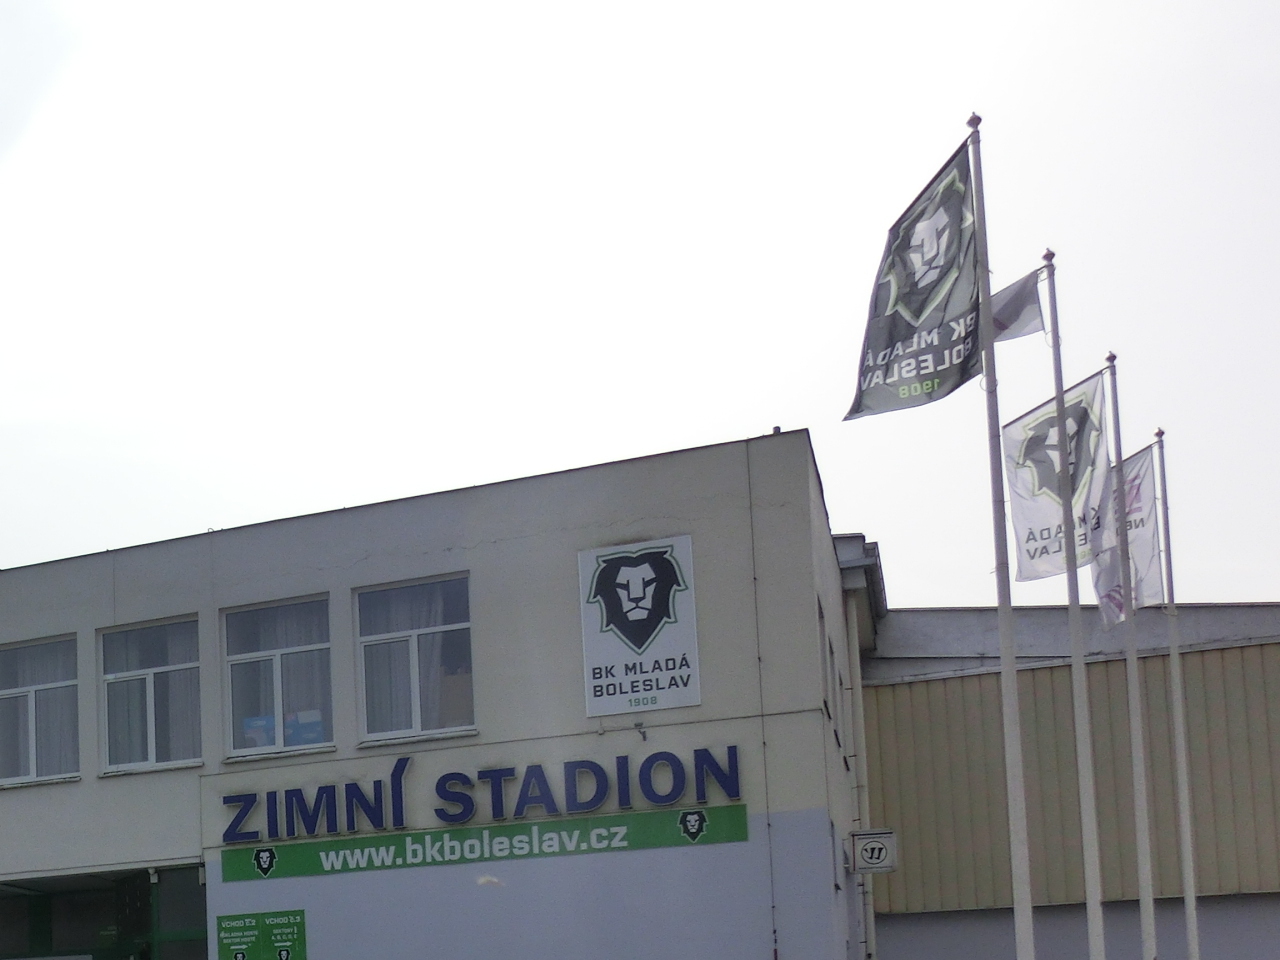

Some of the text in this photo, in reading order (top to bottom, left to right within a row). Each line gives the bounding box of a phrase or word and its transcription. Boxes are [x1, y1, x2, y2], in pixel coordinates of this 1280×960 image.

[592, 653, 691, 680] BK MLADÁ
[593, 674, 691, 698] BOLESLAV
[628, 696, 658, 708] 1908
[222, 744, 742, 845] ZIMNÍ STADION
[320, 824, 629, 872] www.bkboleslav.cz
